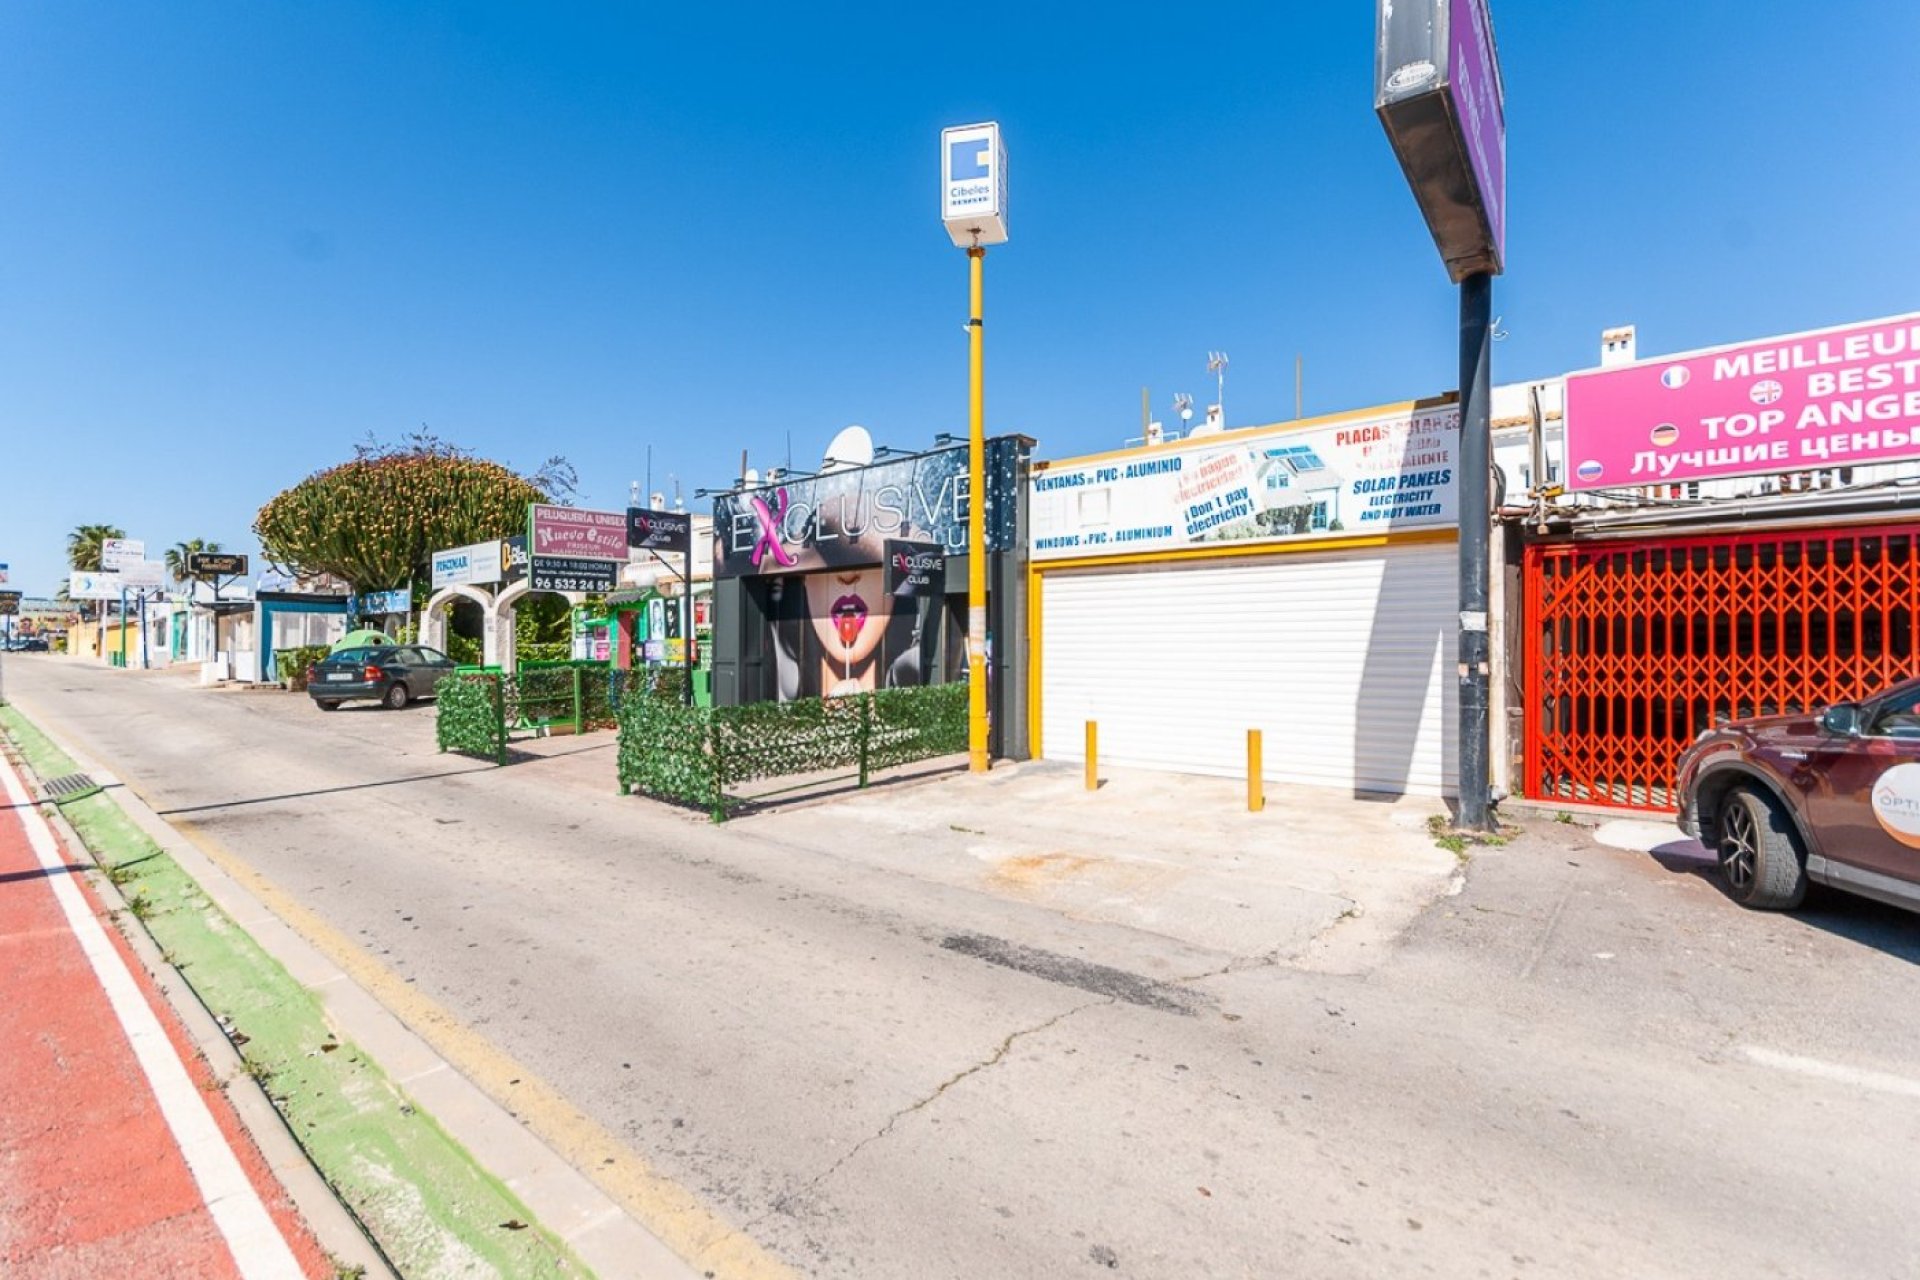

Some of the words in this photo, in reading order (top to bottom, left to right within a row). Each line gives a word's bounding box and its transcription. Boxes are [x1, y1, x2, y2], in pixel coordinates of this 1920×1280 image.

[951, 185, 990, 197] Cibeles
[1713, 325, 1920, 381] MEILLEU
[1807, 358, 1920, 398] BEST
[1700, 409, 1785, 440] TOP
[1336, 425, 1390, 446] PLACAS
[1035, 472, 1086, 492] VENTANAS
[1096, 467, 1118, 483] PVC
[1125, 457, 1182, 479] ALUMINIO
[1353, 476, 1396, 494] SOLAR
[1398, 469, 1451, 490] PANELS
[1225, 487, 1249, 506] pay
[1369, 489, 1433, 506] ELECTRICITY
[595, 514, 627, 527] UNISEX
[732, 473, 971, 567] EXCLUSIVE
[1360, 509, 1382, 521] AND
[1382, 506, 1403, 519] HOT
[1404, 503, 1441, 517] WATER
[634, 514, 685, 534] EXCLUSIVE
[538, 526, 584, 546] Nuevo
[649, 534, 671, 543] CLUB
[1035, 535, 1079, 549] WINDOWS
[1088, 531, 1107, 545] PVC
[1115, 525, 1172, 542] ALUMINIUM
[892, 553, 943, 573] EXCLUSIVE
[535, 577, 551, 589] 96
[554, 578, 577, 590] 532
[908, 575, 930, 585] CLUB
